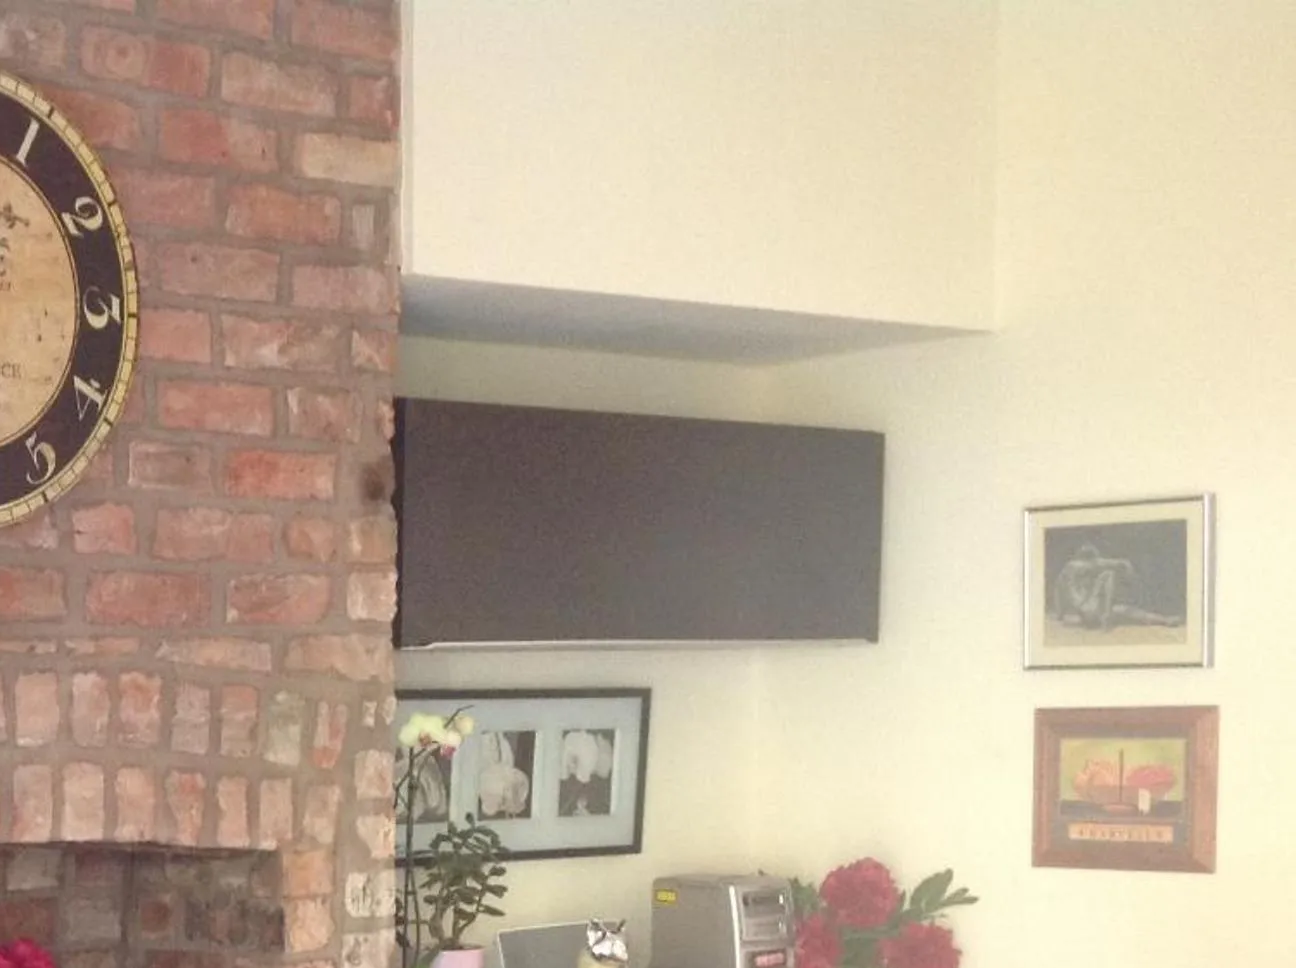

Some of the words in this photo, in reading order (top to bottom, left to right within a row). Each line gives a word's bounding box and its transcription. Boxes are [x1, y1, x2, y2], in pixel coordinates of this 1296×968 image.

[15, 118, 41, 168] 1
[62, 196, 104, 239] 2
[83, 286, 122, 331] 3
[72, 372, 110, 422] 4
[25, 430, 57, 486] 5
